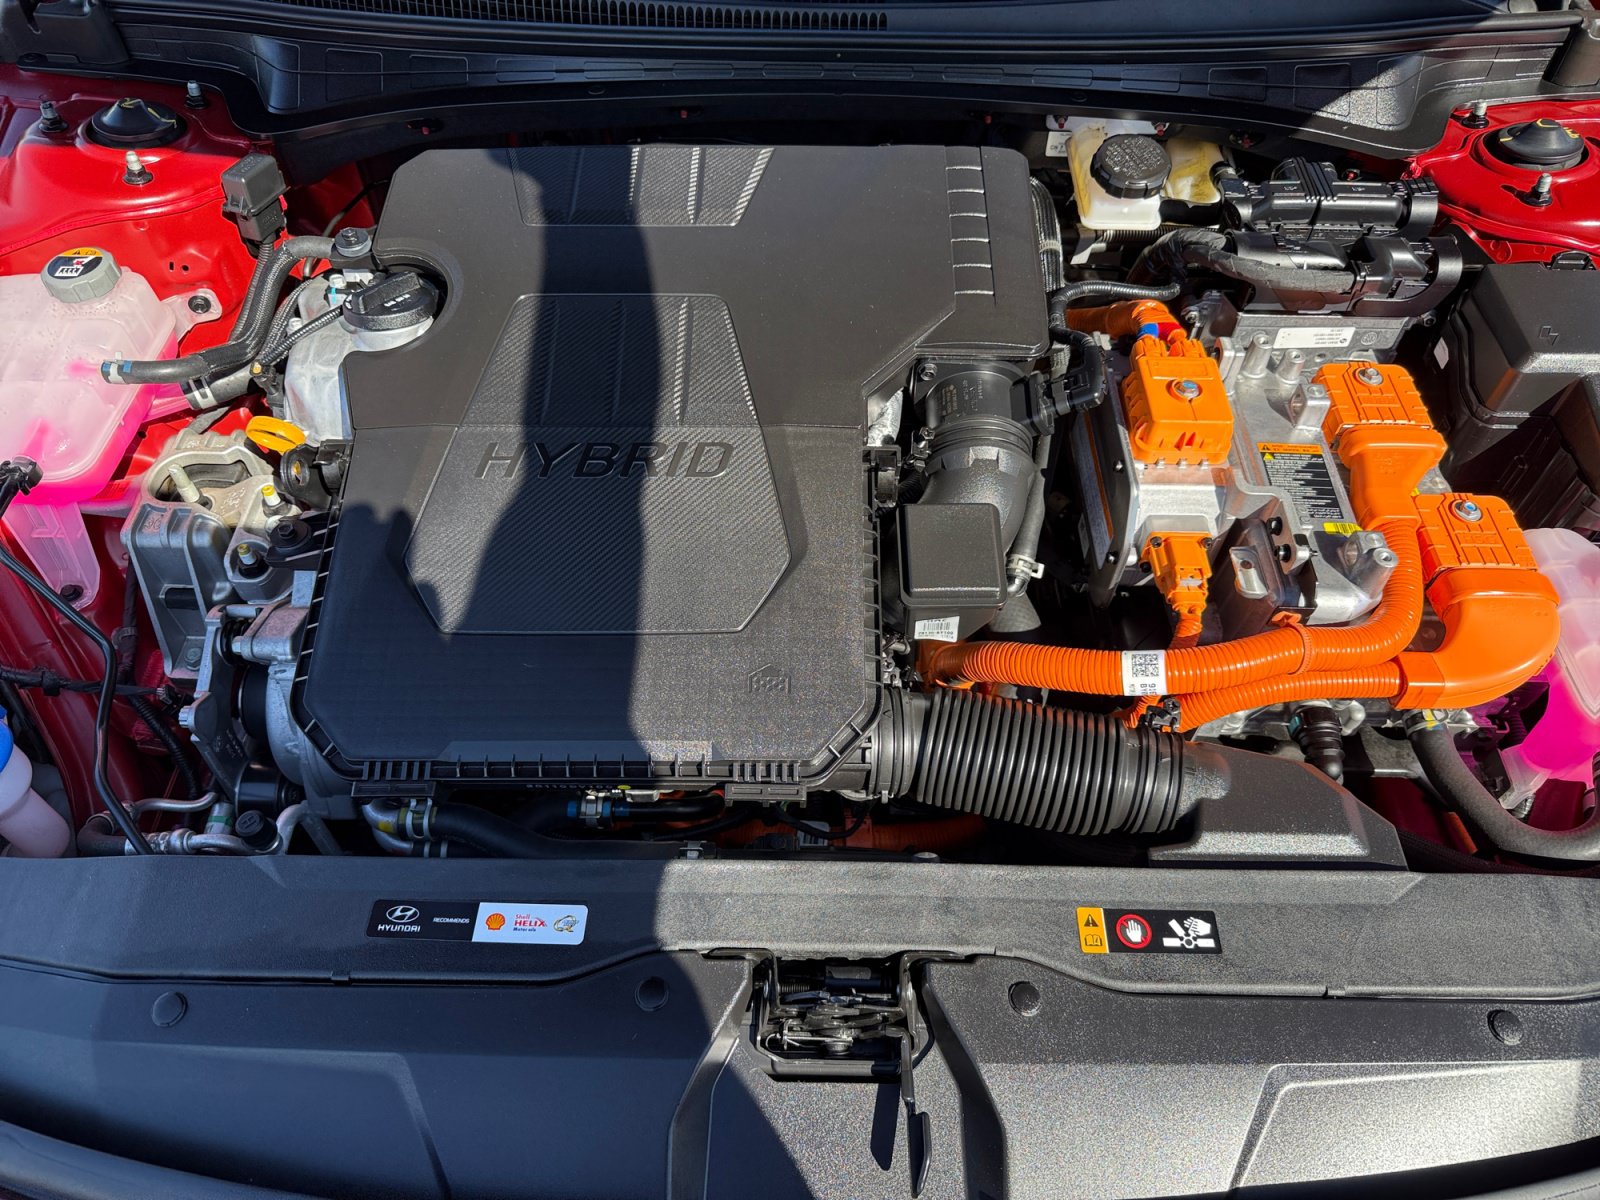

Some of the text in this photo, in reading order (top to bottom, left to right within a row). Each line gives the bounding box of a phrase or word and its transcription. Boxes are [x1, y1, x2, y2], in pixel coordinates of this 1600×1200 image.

[474, 442, 734, 479] HYBRID
[377, 923, 421, 933] HYUNDAI
[514, 918, 545, 928] HELIX
